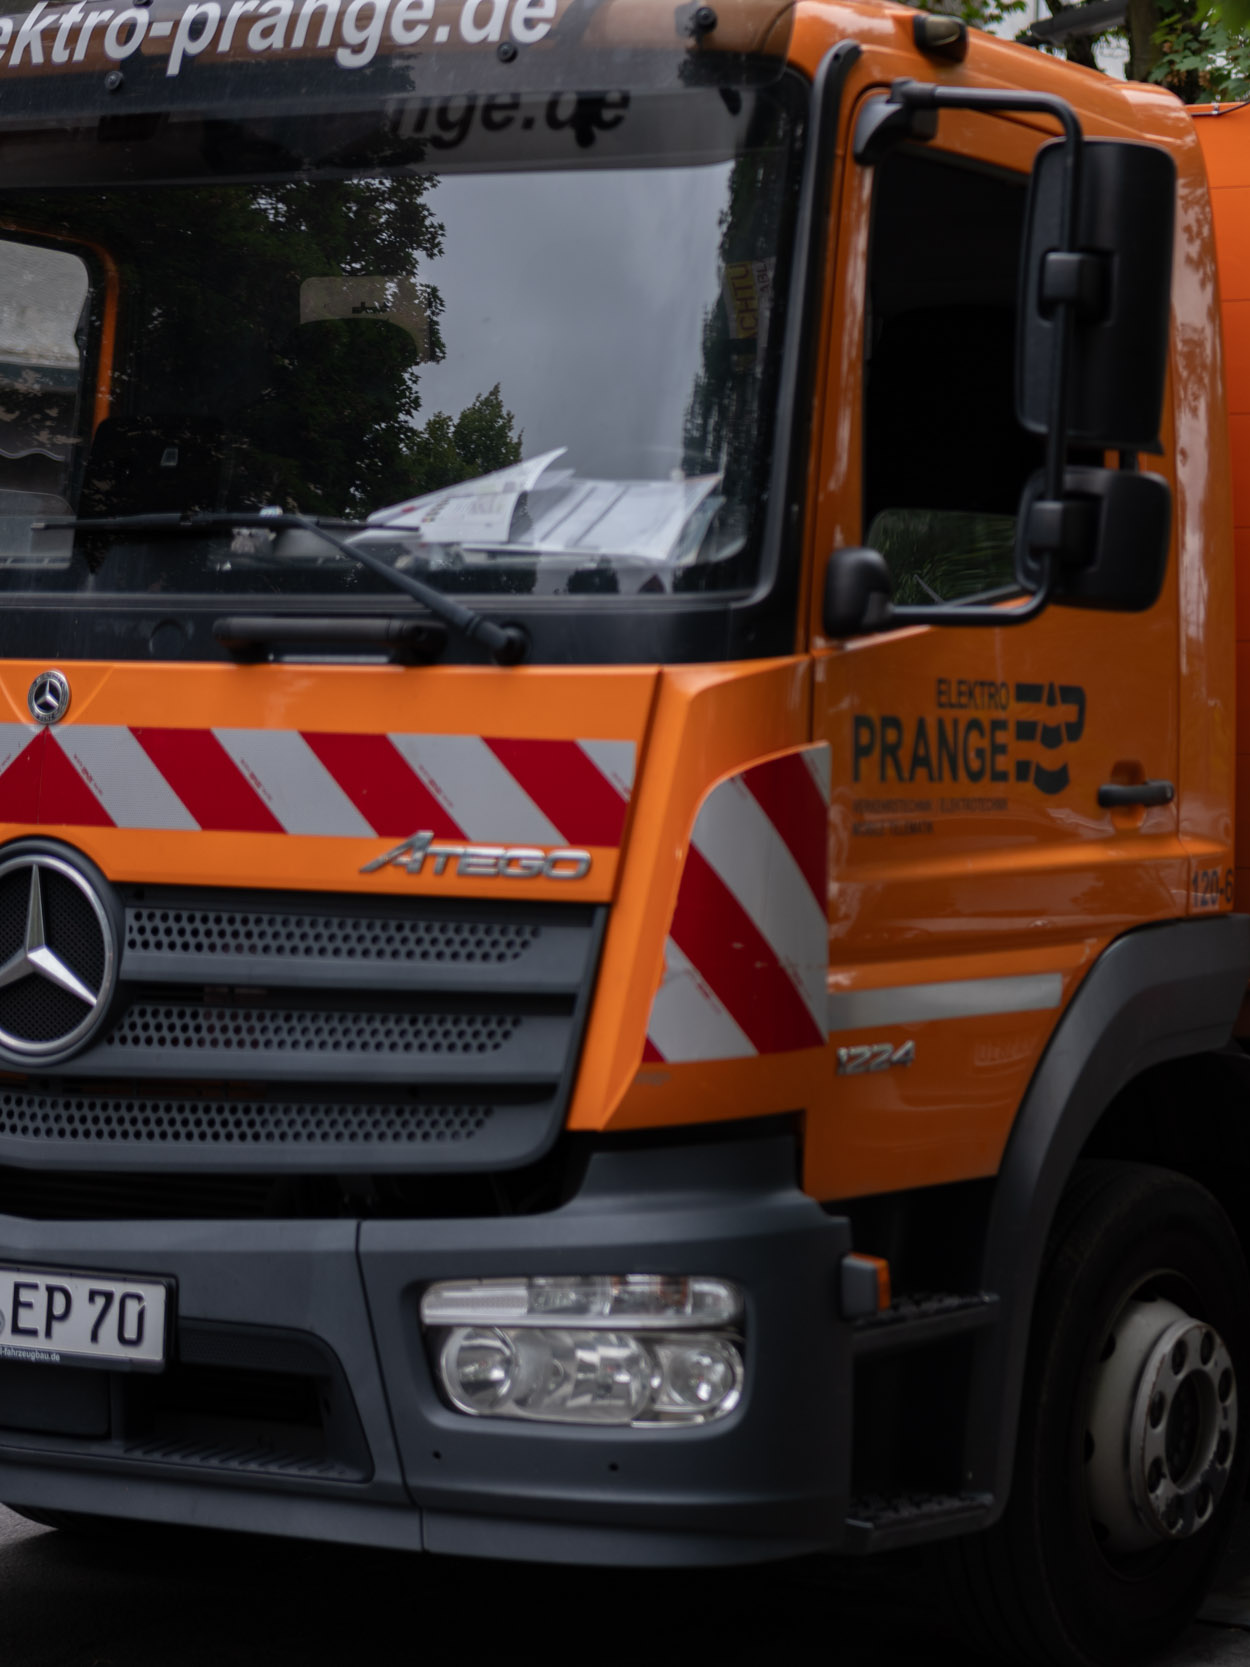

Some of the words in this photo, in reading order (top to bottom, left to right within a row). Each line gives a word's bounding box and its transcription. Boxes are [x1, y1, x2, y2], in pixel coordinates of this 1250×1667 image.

[936, 678, 1011, 711] ELEKTRO
[852, 715, 1011, 784] PRANGE
[835, 1039, 917, 1077] 1224
[11, 1280, 72, 1340] EP
[87, 1287, 146, 1347] 70
